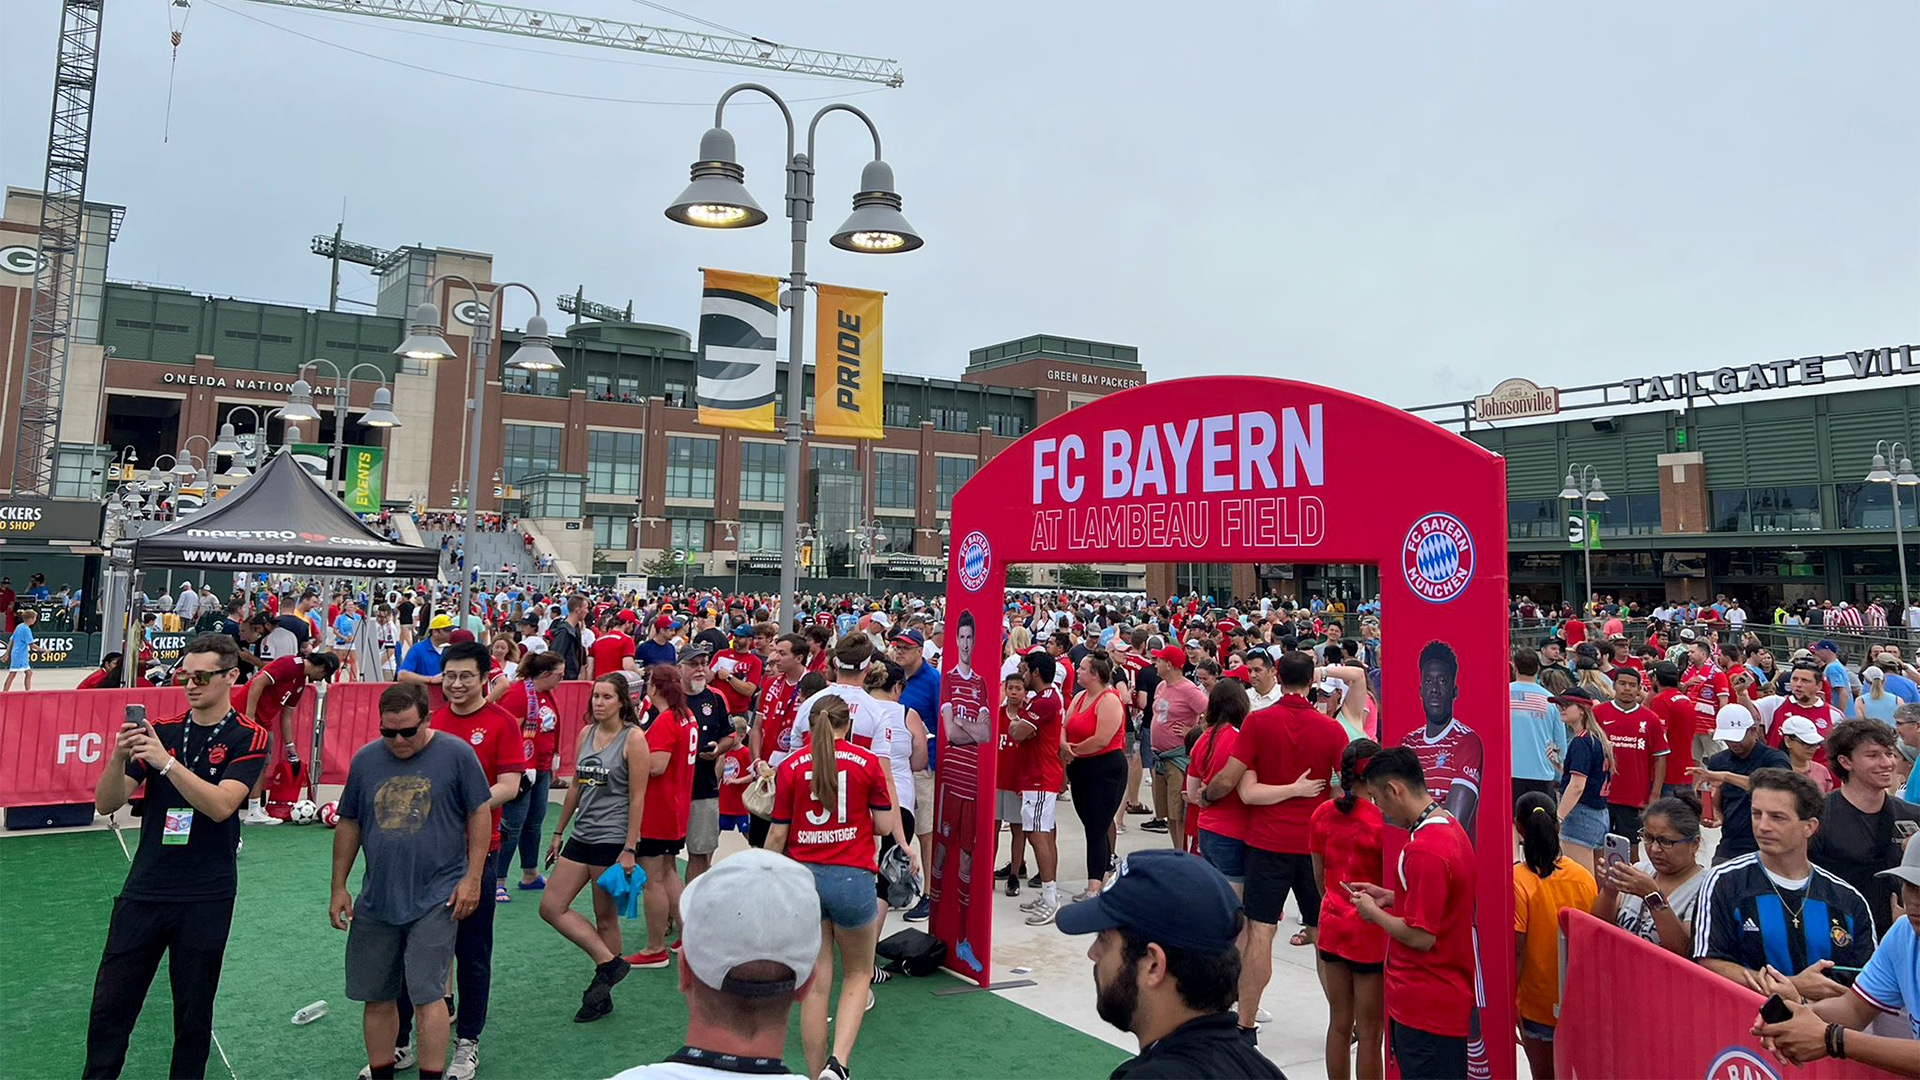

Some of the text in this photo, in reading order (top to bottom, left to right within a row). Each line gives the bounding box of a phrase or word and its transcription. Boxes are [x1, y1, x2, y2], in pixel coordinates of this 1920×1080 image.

[837, 309, 861, 412] PRIDE
[164, 373, 337, 396] ONEIDA NATION AT
[1047, 369, 1140, 389] GREEN BAY PACKERS
[1623, 355, 1825, 404] TAILGATE
[1478, 391, 1553, 419] Johnsonville
[1033, 403, 1324, 504] FC BAYERN
[356, 452, 371, 506] EVENTS
[9, 521, 36, 530] SHOP
[1031, 495, 1325, 551] AT LAMBEAU FIELD
[1407, 518, 1469, 553] FC BAYERN
[961, 534, 989, 557] FC BAYERN
[183, 549, 397, 574] www.maestrocares.org
[1407, 566, 1468, 597] MÜNCHEN
[40, 612, 51, 621] 12
[41, 652, 67, 662] SHOP
[57, 732, 102, 765] FC
[687, 727, 698, 765] 9
[1609, 734, 1637, 743] Standard
[797, 826, 858, 844] SCHWEINSTEIGER
